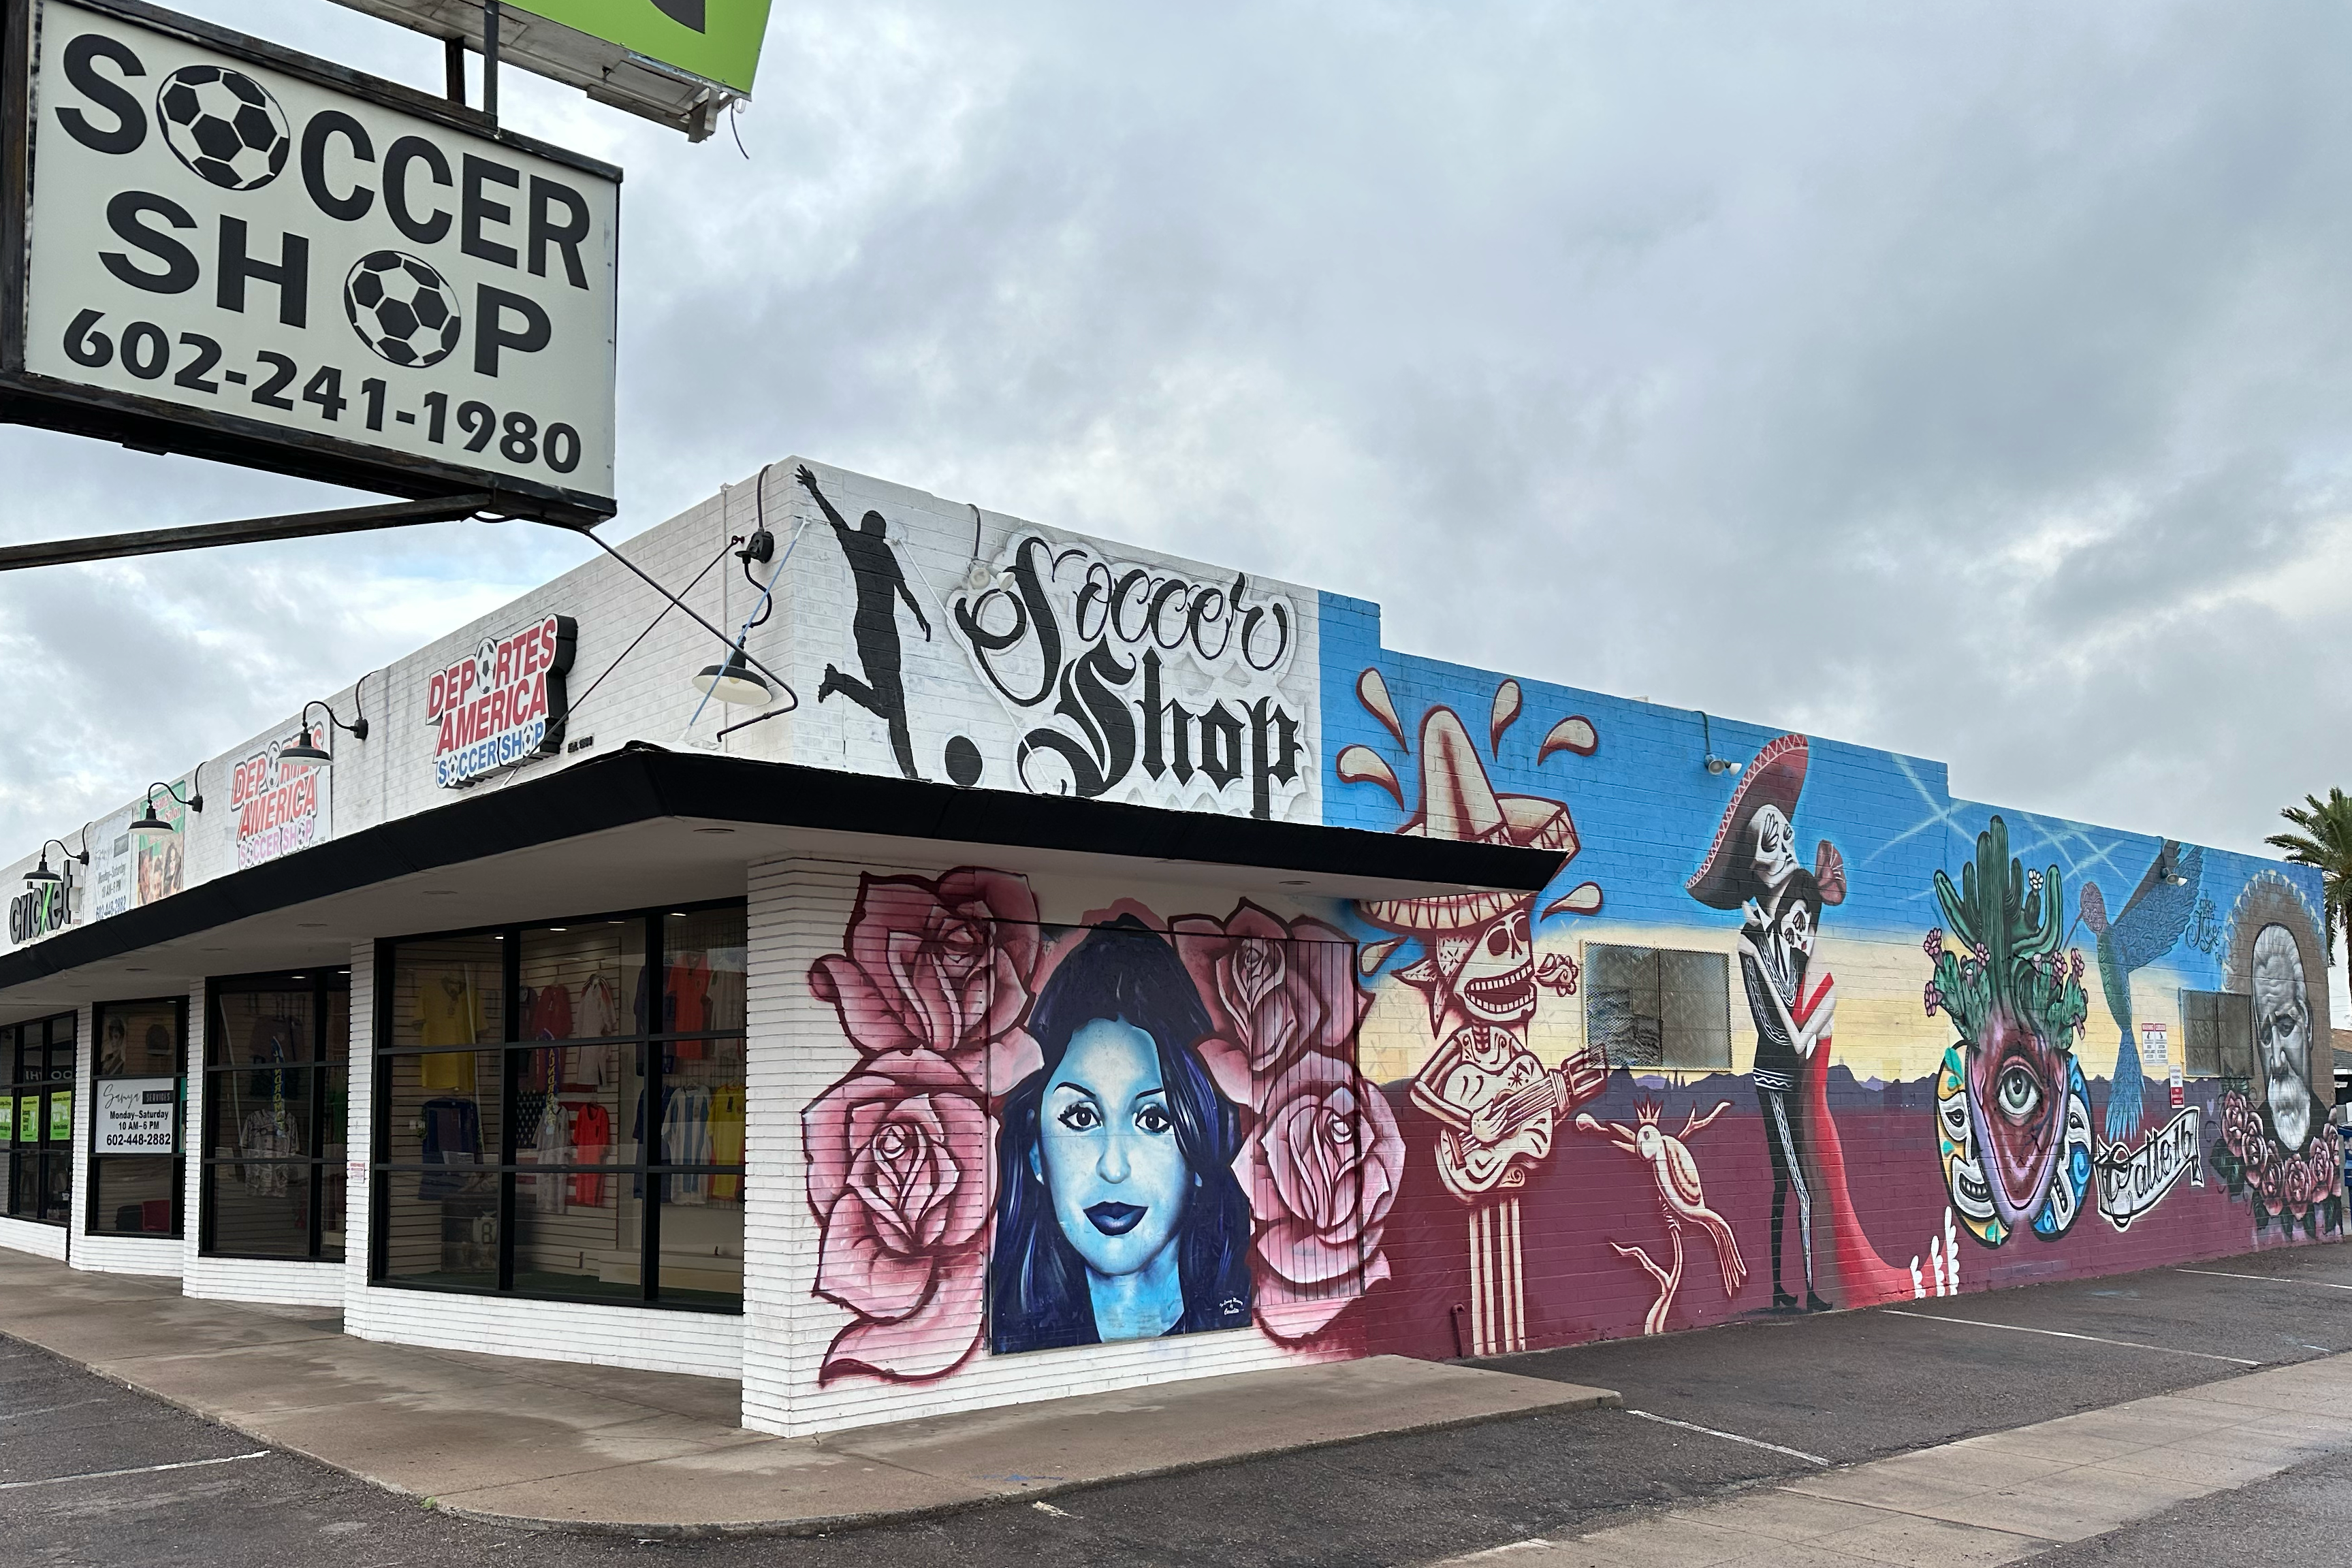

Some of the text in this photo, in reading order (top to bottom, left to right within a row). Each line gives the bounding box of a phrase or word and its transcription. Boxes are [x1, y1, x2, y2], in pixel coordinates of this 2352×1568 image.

[63, 308, 582, 475] 602-241-1980
[955, 537, 1288, 707] Soccer
[436, 671, 547, 757] AMERICA
[1017, 633, 1304, 819] Shop
[238, 773, 315, 841] AMERICA
[10, 860, 72, 944] cricket
[118, 1122, 127, 1130] 10
[149, 1121, 159, 1130] PM
[146, 1092, 170, 1102] SERVICES
[106, 1133, 171, 1146] 602-448-2882
